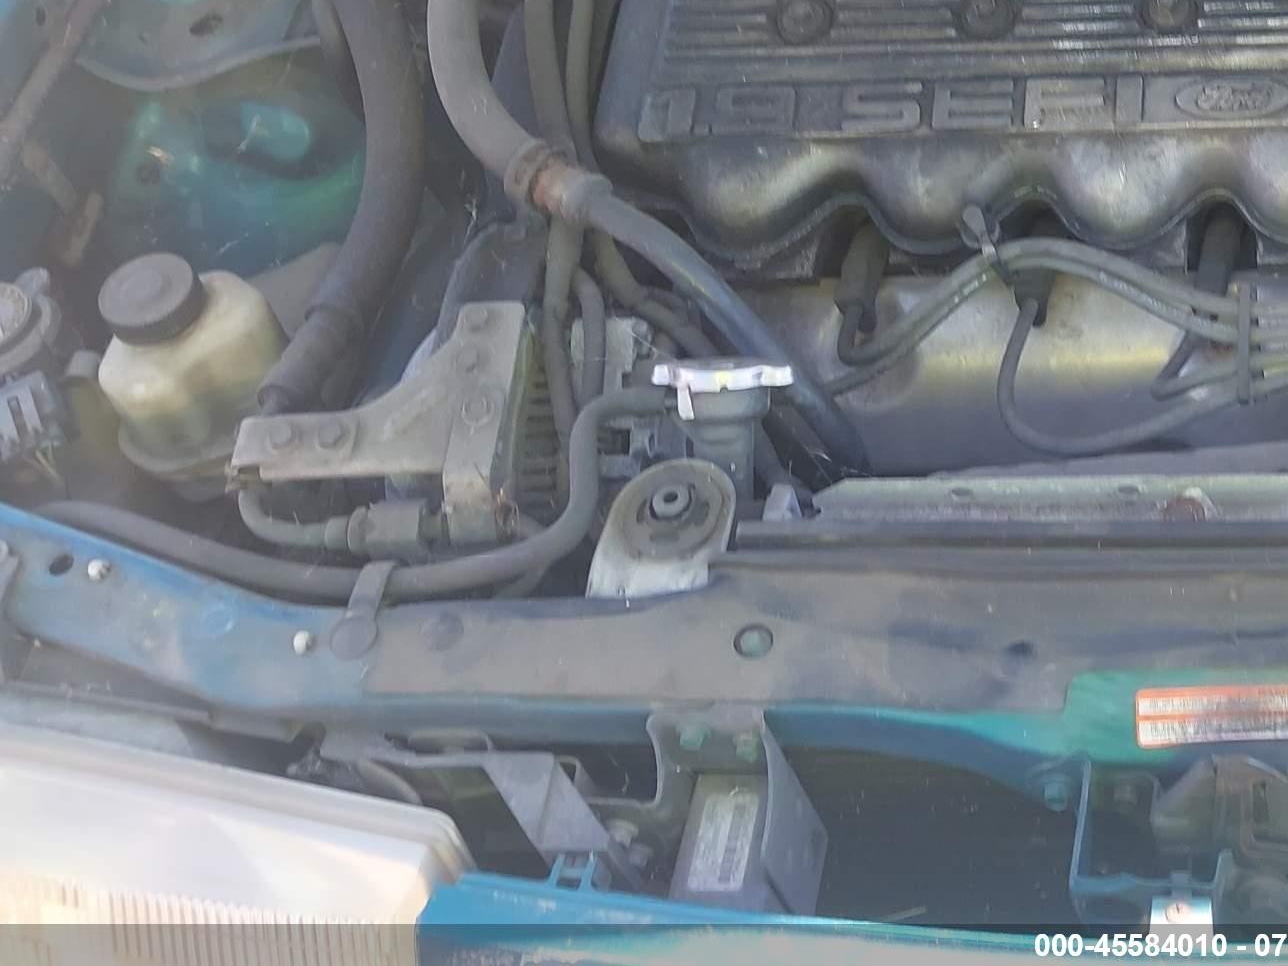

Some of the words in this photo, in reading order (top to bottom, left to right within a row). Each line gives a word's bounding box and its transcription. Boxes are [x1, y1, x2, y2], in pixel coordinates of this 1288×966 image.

[638, 85, 797, 142] 1.9
[841, 75, 1144, 134] SEFI
[1195, 81, 1273, 114] Ford
